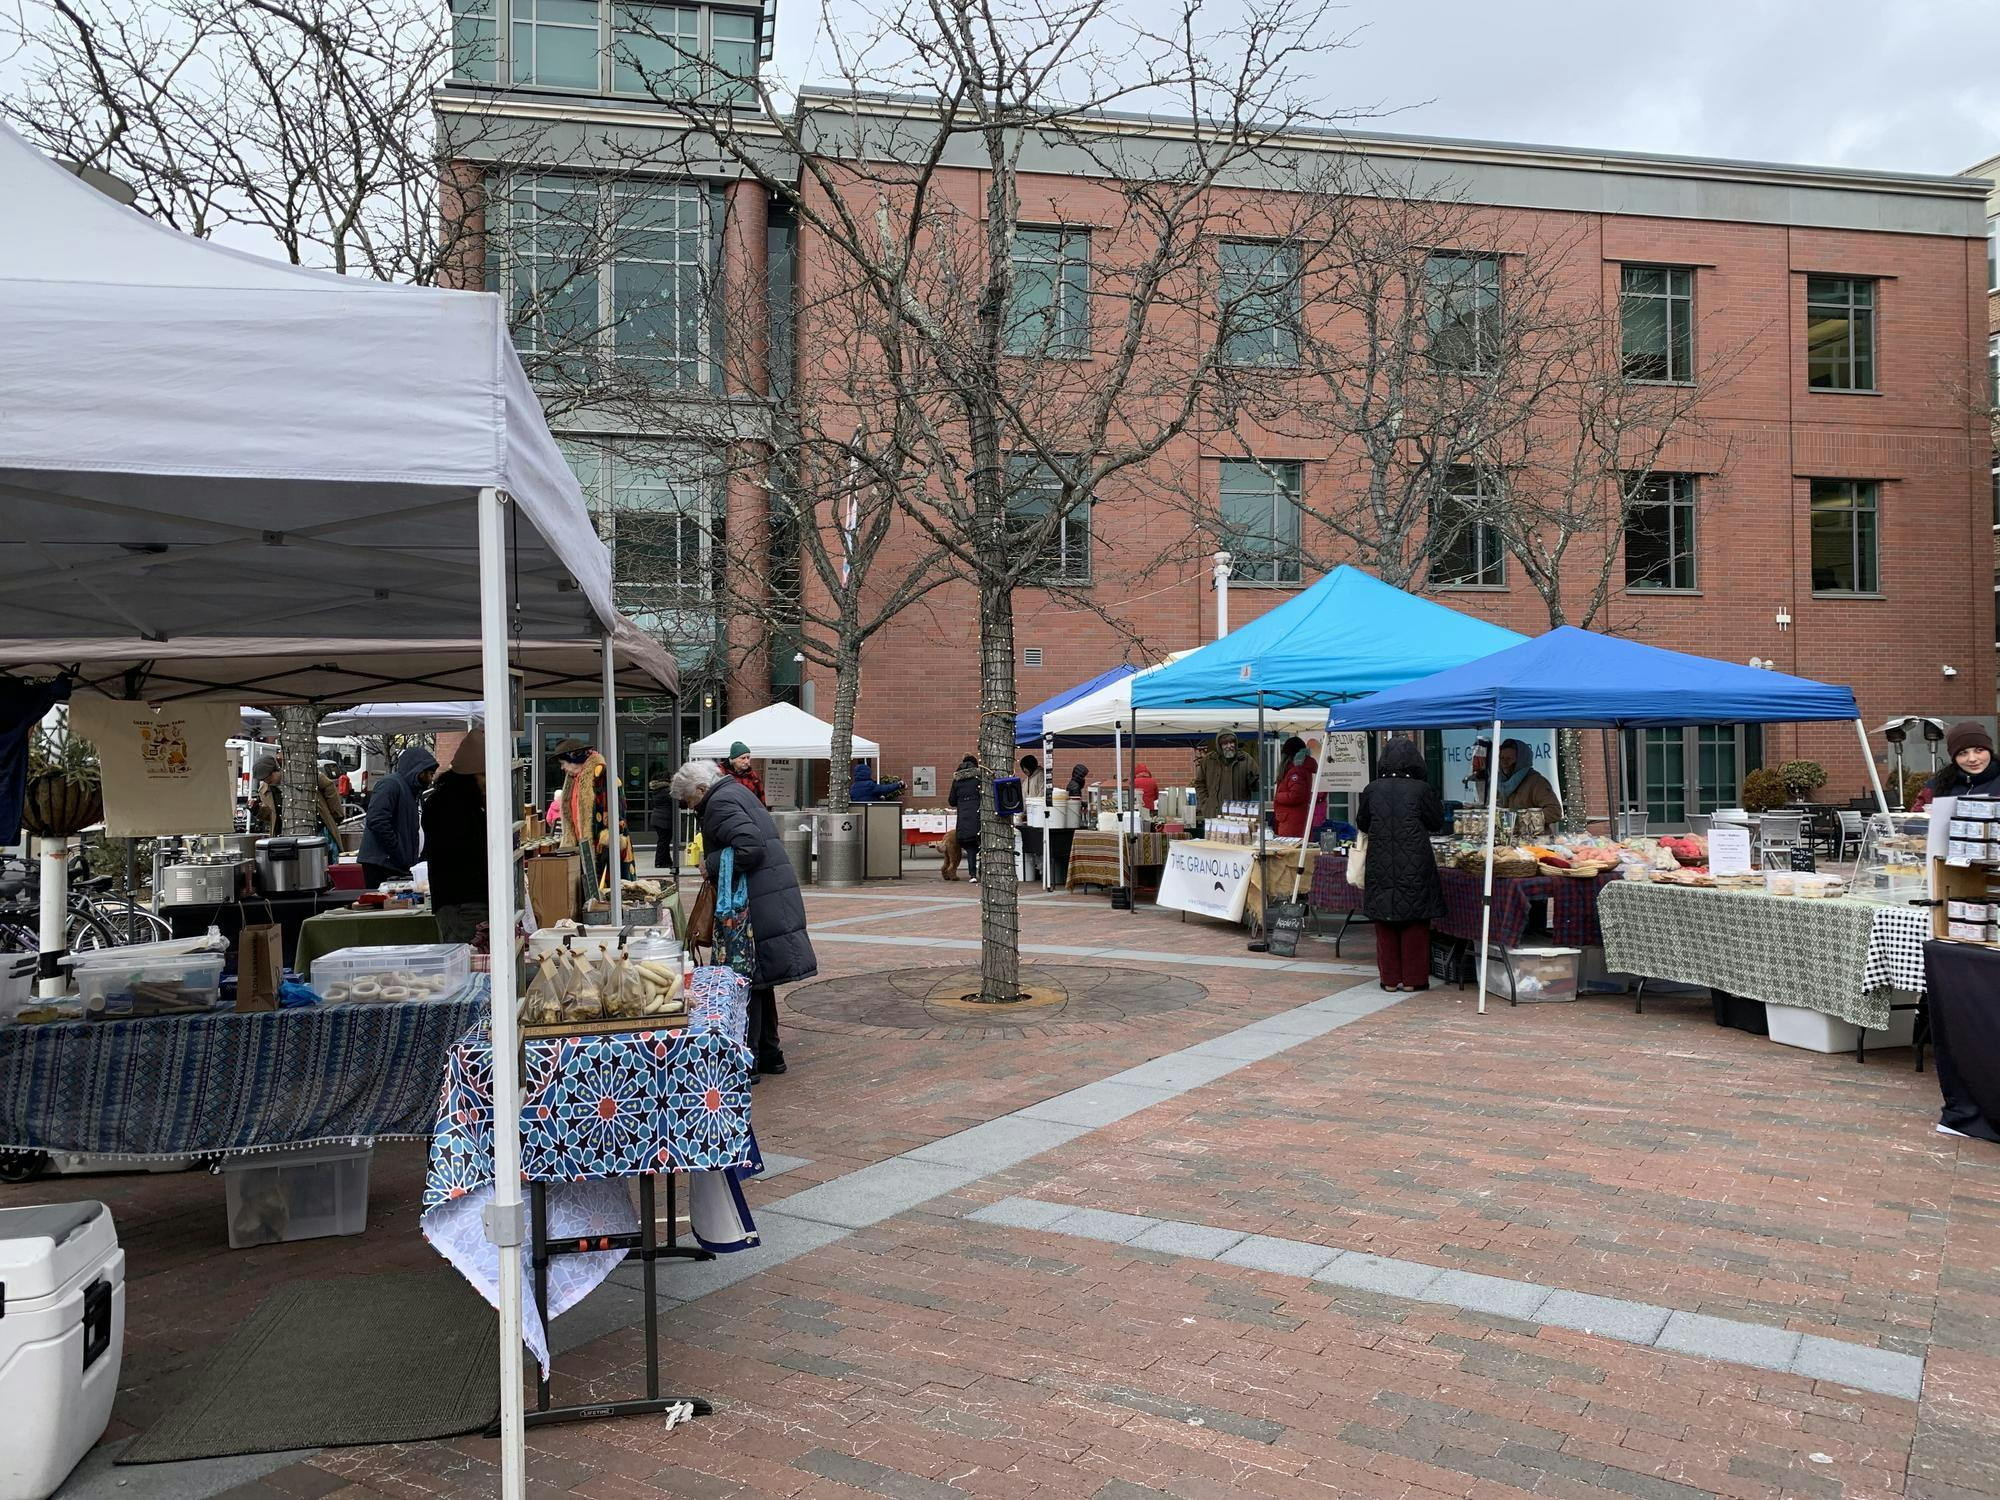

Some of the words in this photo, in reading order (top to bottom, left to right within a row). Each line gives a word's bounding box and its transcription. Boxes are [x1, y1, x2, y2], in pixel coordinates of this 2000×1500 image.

[1443, 747, 1460, 762] THE
[1171, 853, 1185, 871] THE
[1187, 855, 1230, 878] GRANOLA
